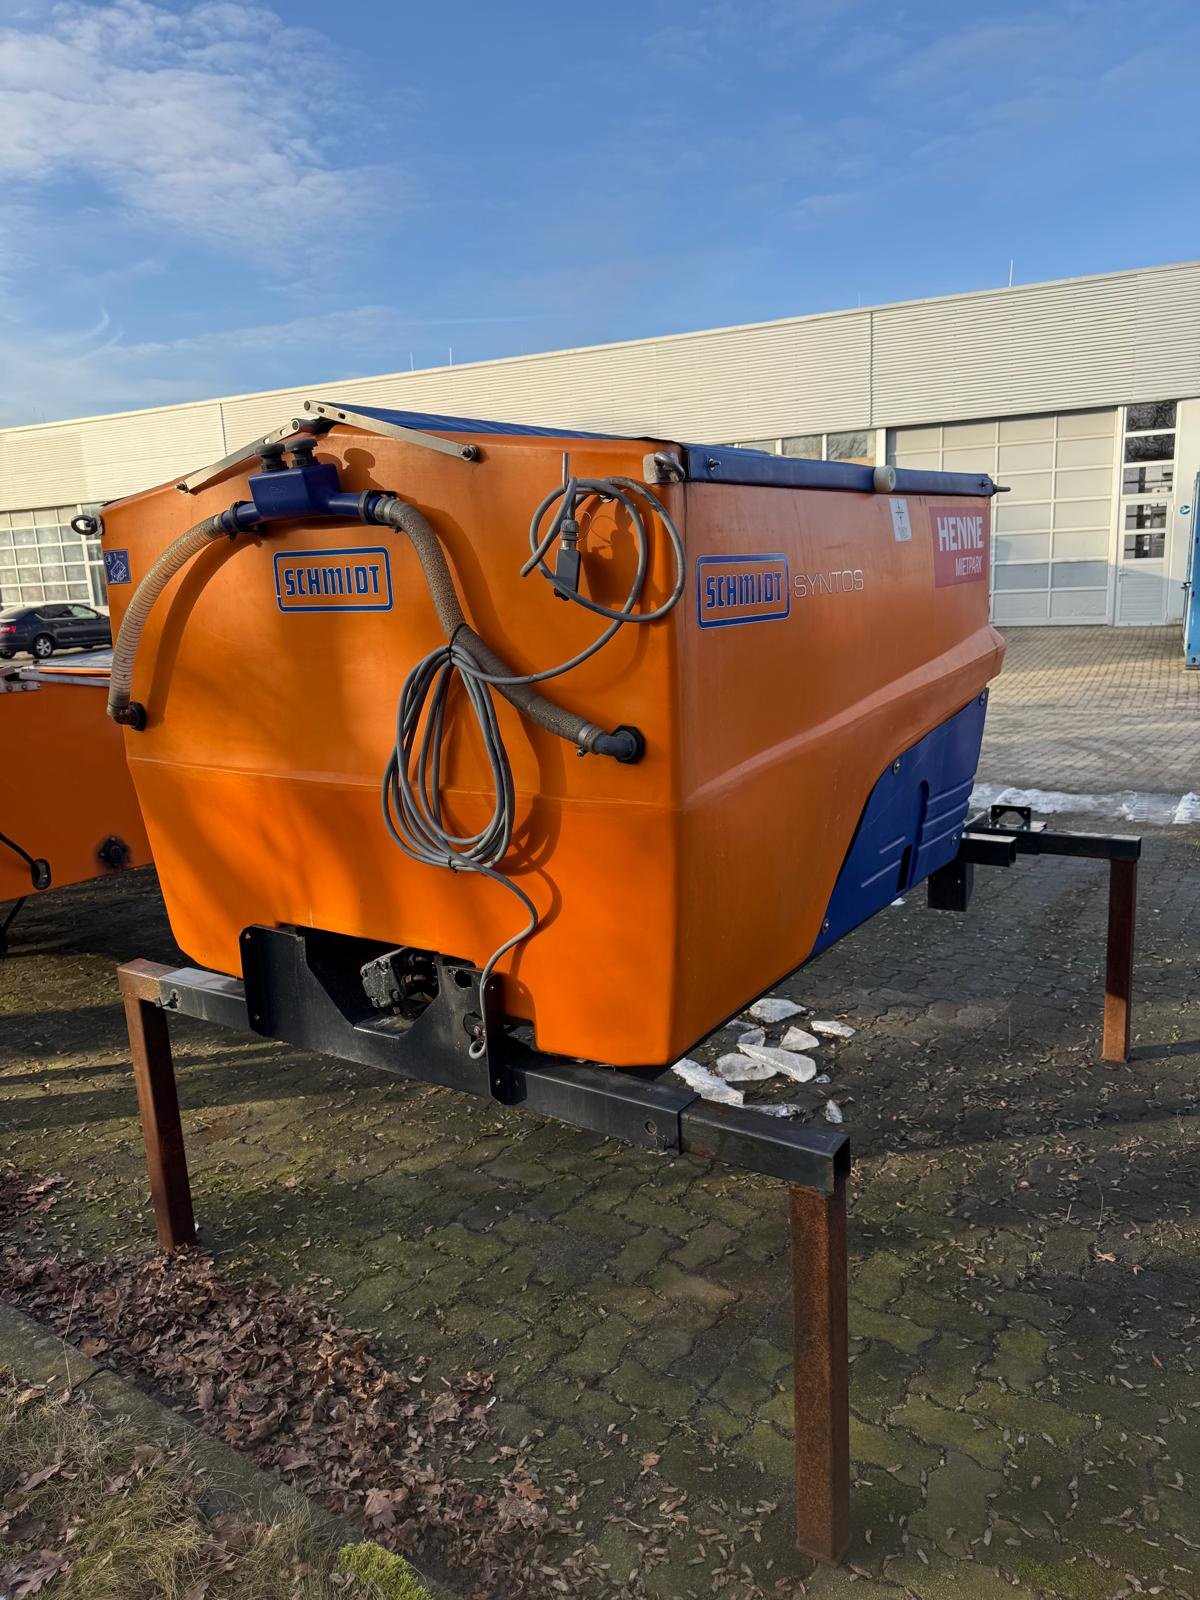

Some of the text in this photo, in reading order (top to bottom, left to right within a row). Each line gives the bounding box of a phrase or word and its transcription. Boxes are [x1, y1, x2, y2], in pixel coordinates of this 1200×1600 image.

[936, 516, 985, 552] HENNE
[284, 565, 380, 597] SCHMIDT
[955, 556, 983, 577] MIETPARK
[706, 571, 783, 609] SCHMIDT
[794, 569, 864, 598] SYNTOS
